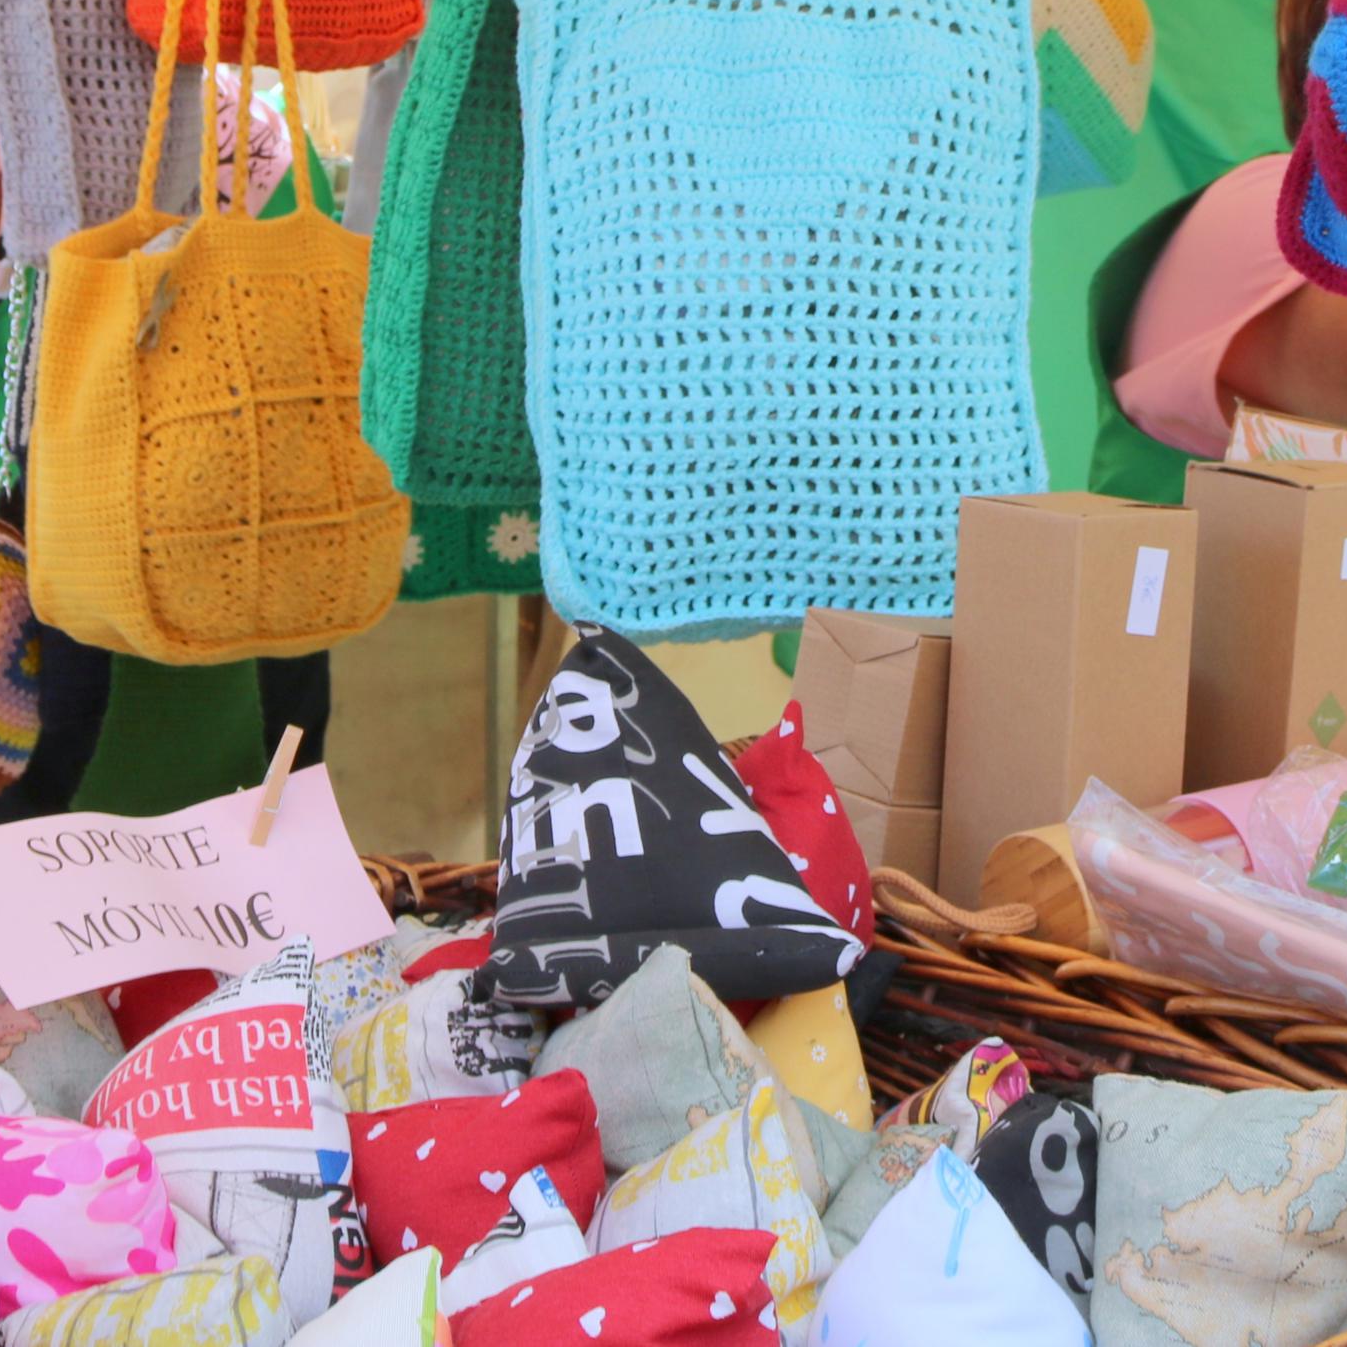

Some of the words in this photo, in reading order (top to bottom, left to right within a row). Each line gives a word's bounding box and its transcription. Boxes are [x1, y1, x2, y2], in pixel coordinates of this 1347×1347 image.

[26, 825, 220, 874] SOPORTE
[169, 1023, 224, 1066] by
[207, 1074, 313, 1121] tish
